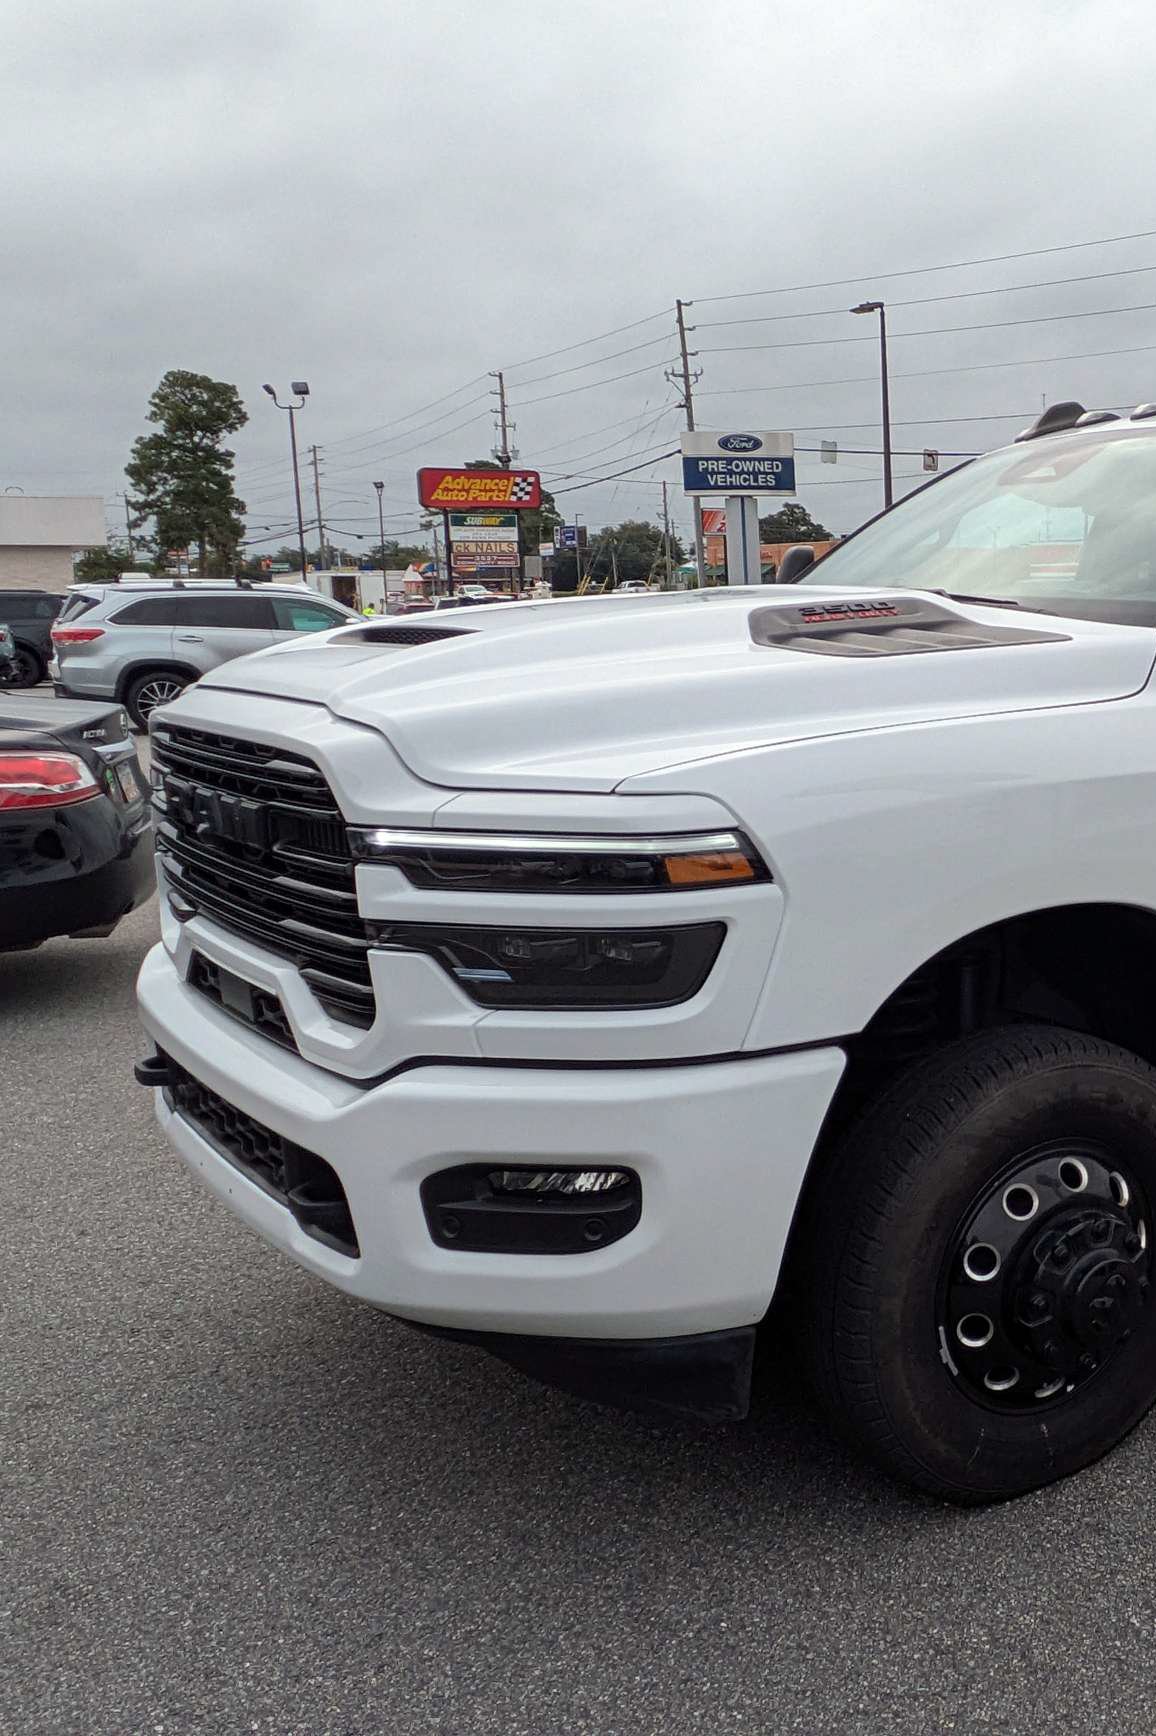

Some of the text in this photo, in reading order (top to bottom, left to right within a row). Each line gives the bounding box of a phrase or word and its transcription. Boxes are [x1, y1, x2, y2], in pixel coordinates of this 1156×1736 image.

[727, 436, 754, 449] Ford
[698, 460, 782, 473] PRE-OWNED
[438, 475, 508, 490] Advance
[707, 474, 776, 487] VEHICLES
[431, 488, 506, 501] Auto Parts
[475, 542, 515, 553] NAILS
